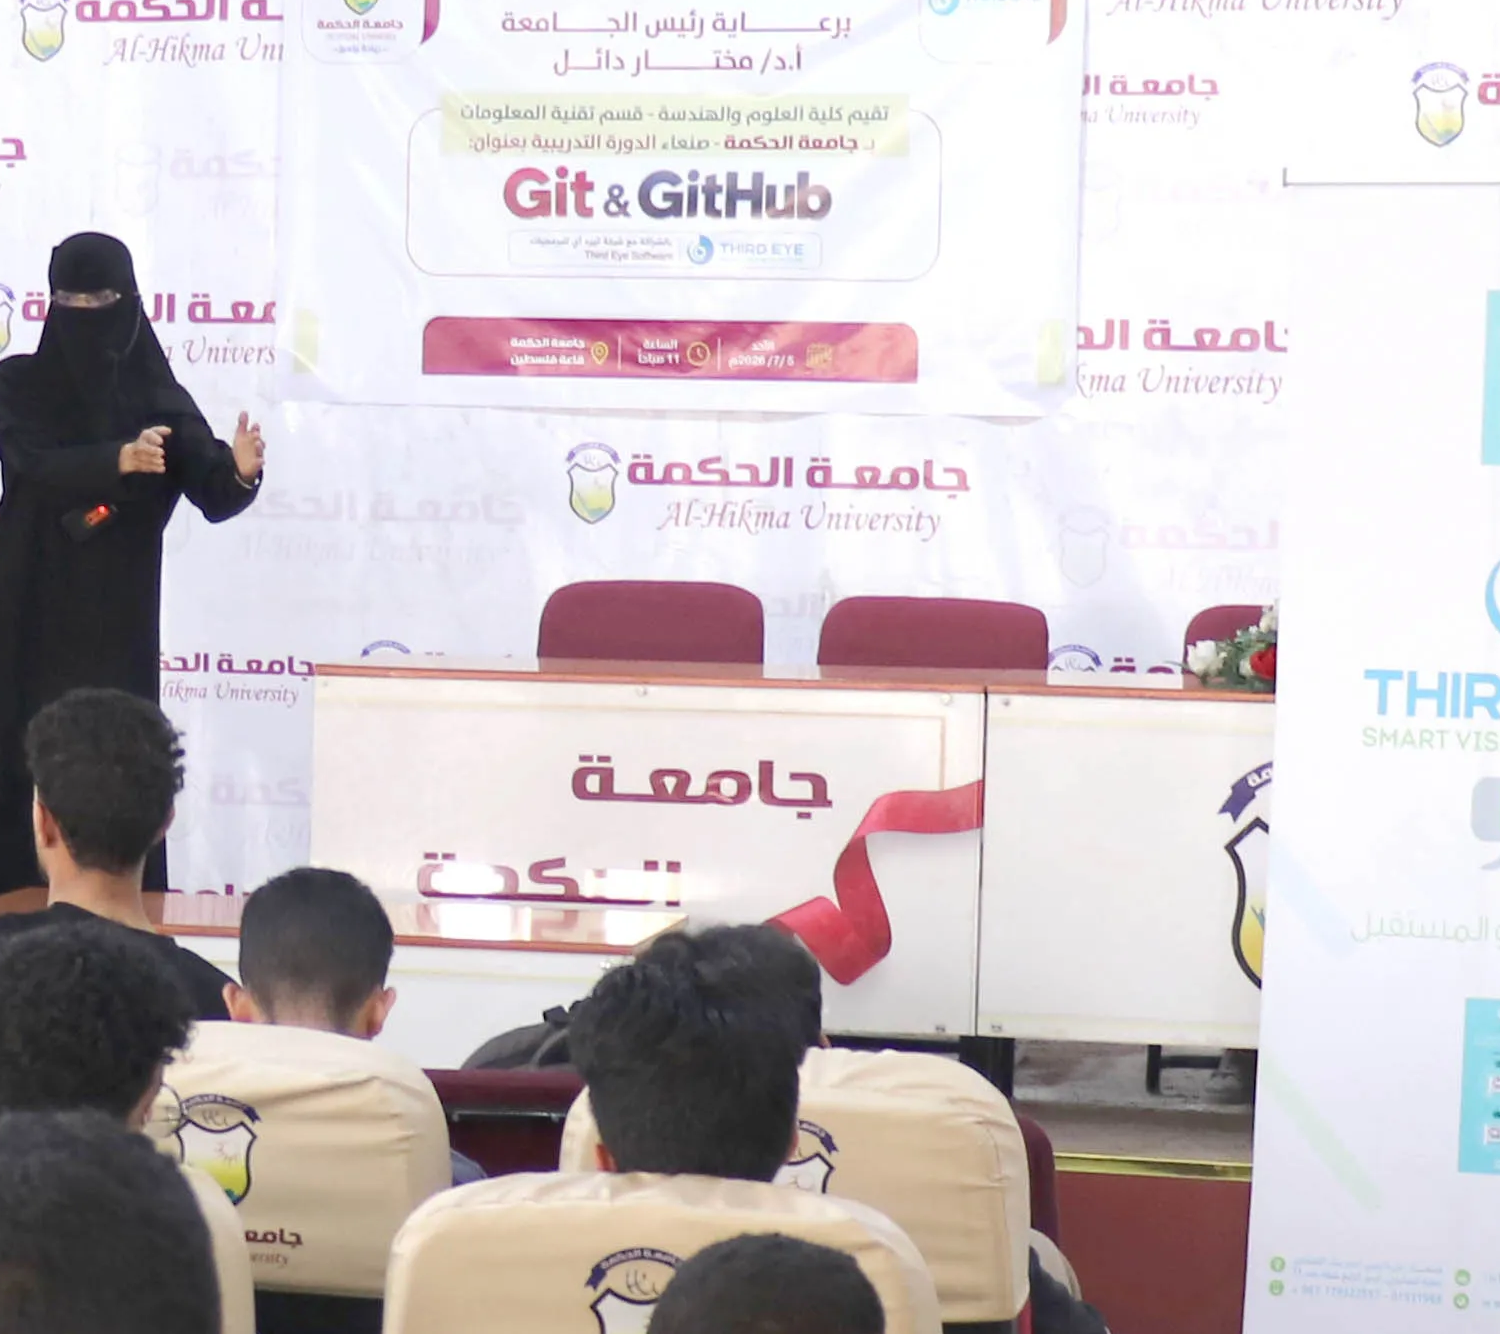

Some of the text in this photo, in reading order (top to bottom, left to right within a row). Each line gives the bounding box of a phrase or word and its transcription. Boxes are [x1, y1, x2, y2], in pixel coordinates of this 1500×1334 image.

[501, 8, 853, 40] برعاية رئيس الجامعة
[102, 33, 226, 69] Al-Hikma
[553, 48, 626, 77] دائل
[630, 49, 754, 78] مختار
[1109, 73, 1220, 102] جامعة
[460, 104, 889, 128] تقيم كلية العلوم والهندسة قسم تقنية المعلومات
[531, 133, 601, 155] التدريبية
[605, 133, 657, 155] الدورة
[661, 134, 711, 152] صنعاء
[723, 134, 794, 151] الحكمة
[798, 134, 859, 154] جامعة
[503, 165, 833, 220] Git & GitHub
[722, 241, 805, 256] THIRD EYE
[1136, 364, 1283, 405] University
[627, 453, 971, 500] جامعة الحكمة
[656, 498, 942, 544] Al-Hikma University
[216, 653, 316, 682] جامعة
[1361, 725, 1451, 750] SMART
[571, 754, 834, 820] جامعة
[1350, 909, 1490, 947] المستقبل
